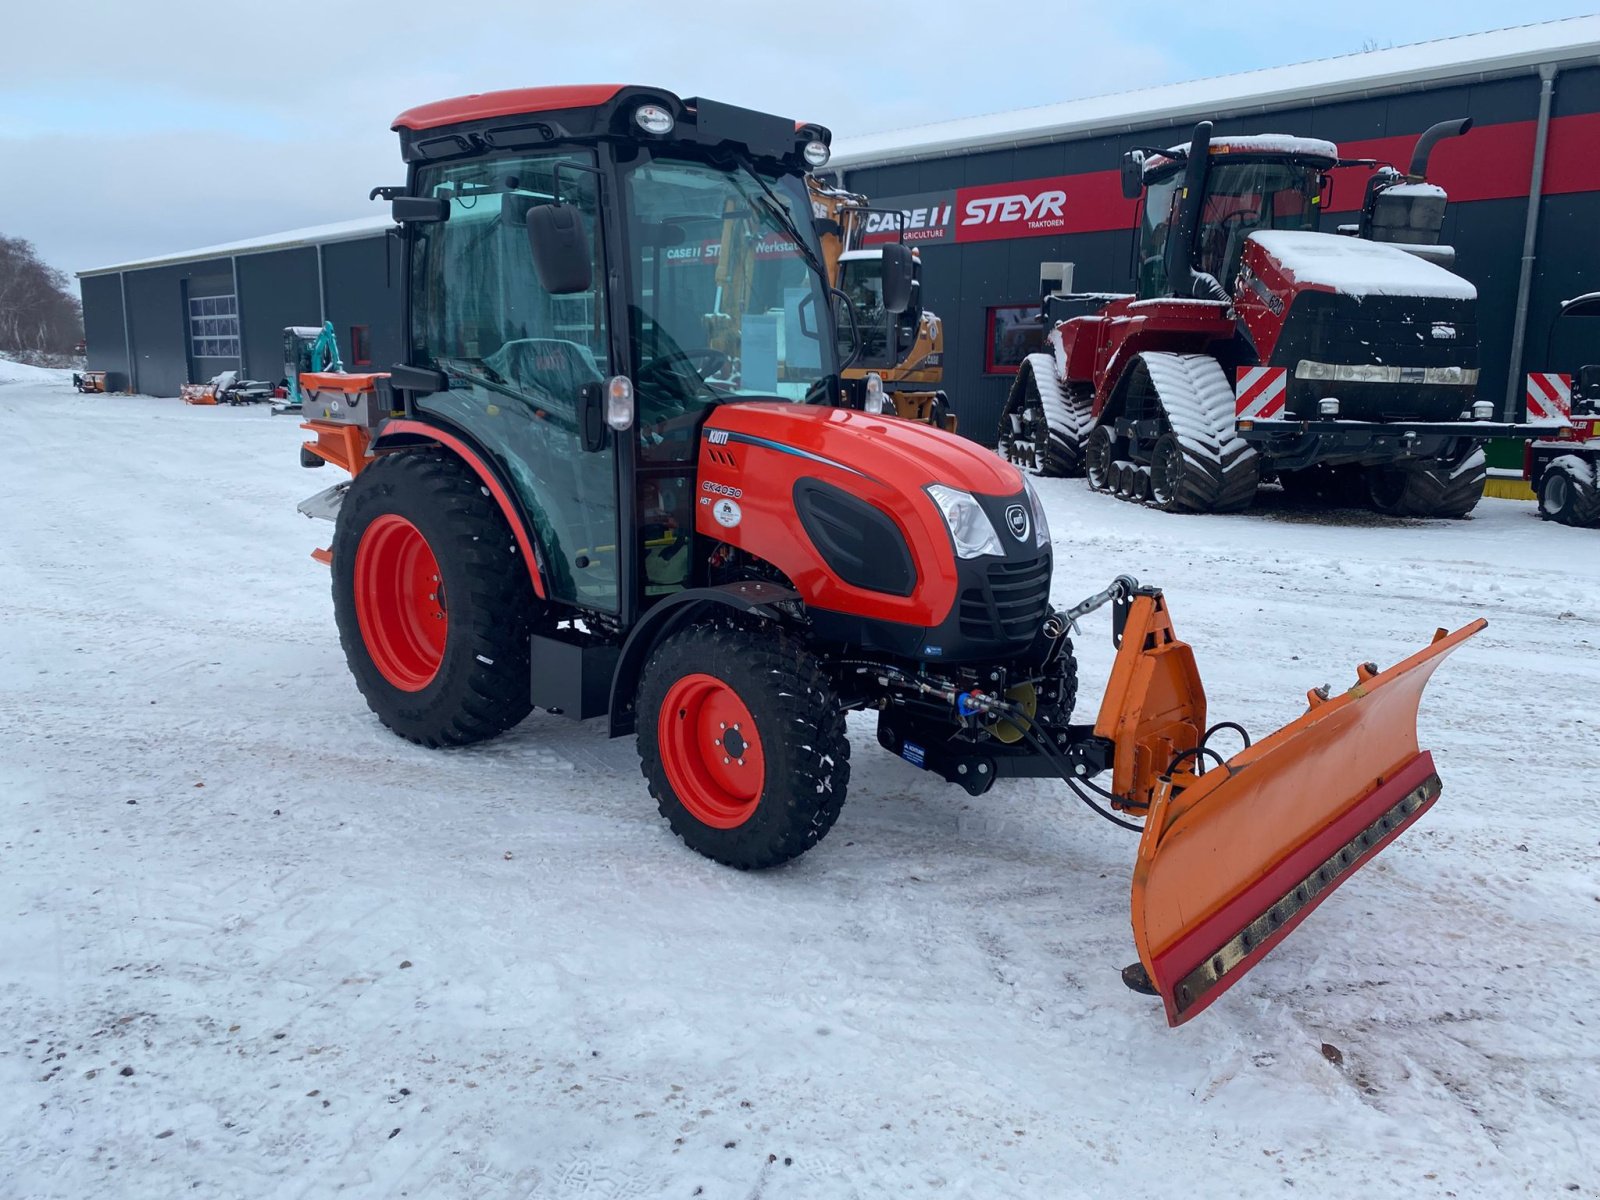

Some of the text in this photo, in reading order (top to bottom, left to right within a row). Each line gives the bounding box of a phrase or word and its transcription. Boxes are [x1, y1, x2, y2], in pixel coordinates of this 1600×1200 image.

[961, 190, 1067, 226] STEYR
[865, 208, 929, 233] CASE
[1028, 219, 1064, 229] TRAKTOREN
[902, 229, 944, 240] GRICULTURE
[756, 241, 802, 254] Werkstat
[1269, 295, 1283, 315] 620
[708, 430, 728, 445] KIOTI
[702, 481, 742, 499] CK4030
